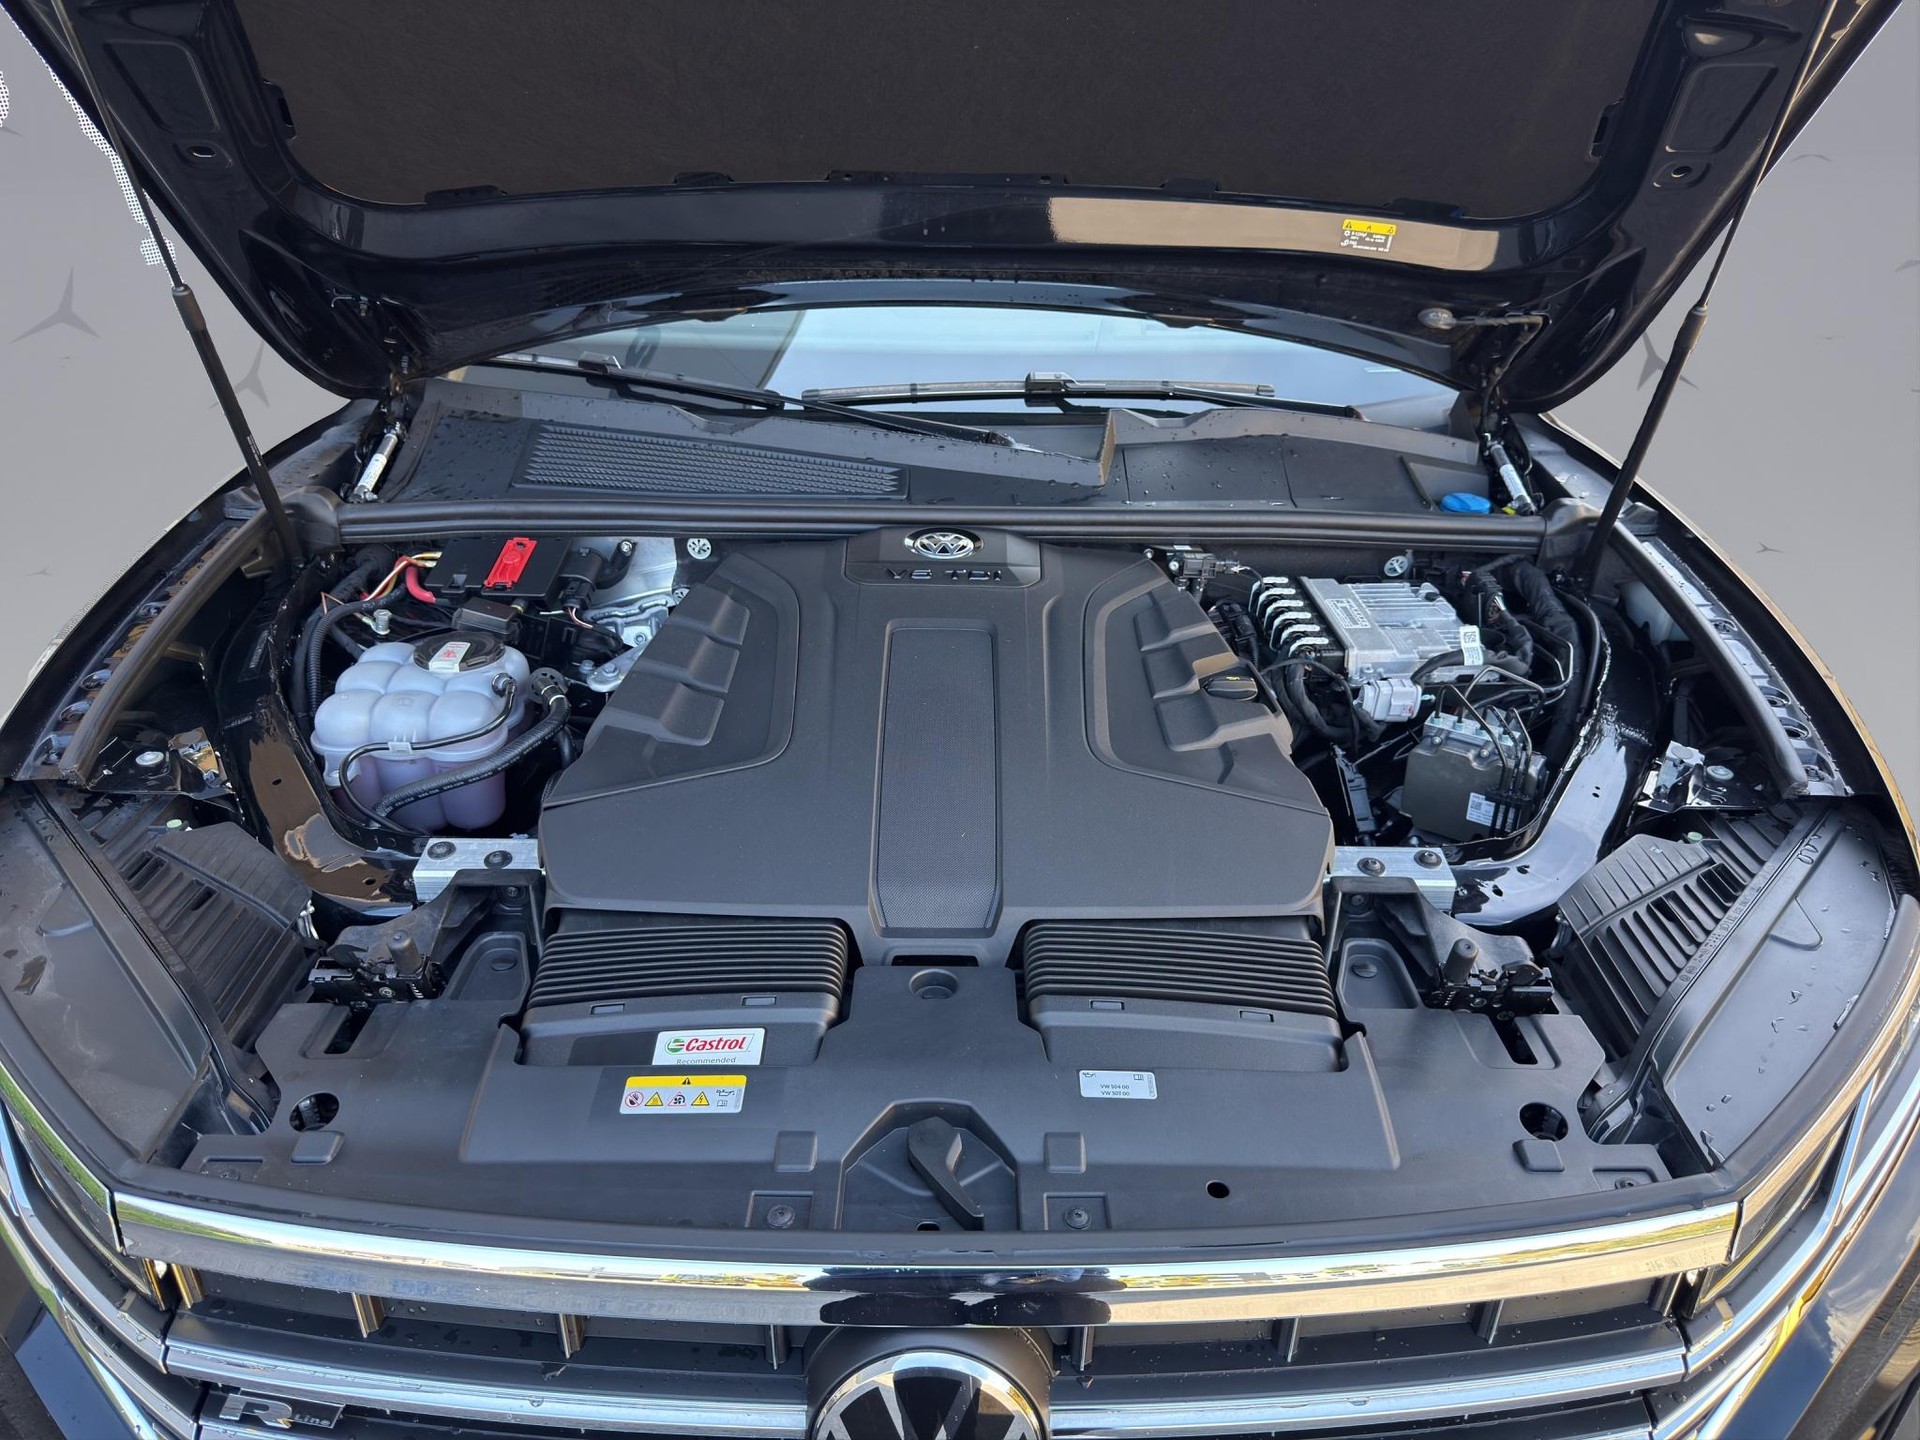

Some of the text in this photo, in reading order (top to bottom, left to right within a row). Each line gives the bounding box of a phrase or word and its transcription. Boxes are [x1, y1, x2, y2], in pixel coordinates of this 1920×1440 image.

[945, 569, 1001, 581] TDI
[685, 1037, 747, 1051] Castrol
[676, 1057, 736, 1065] Recommended
[219, 1393, 331, 1429] R Line
